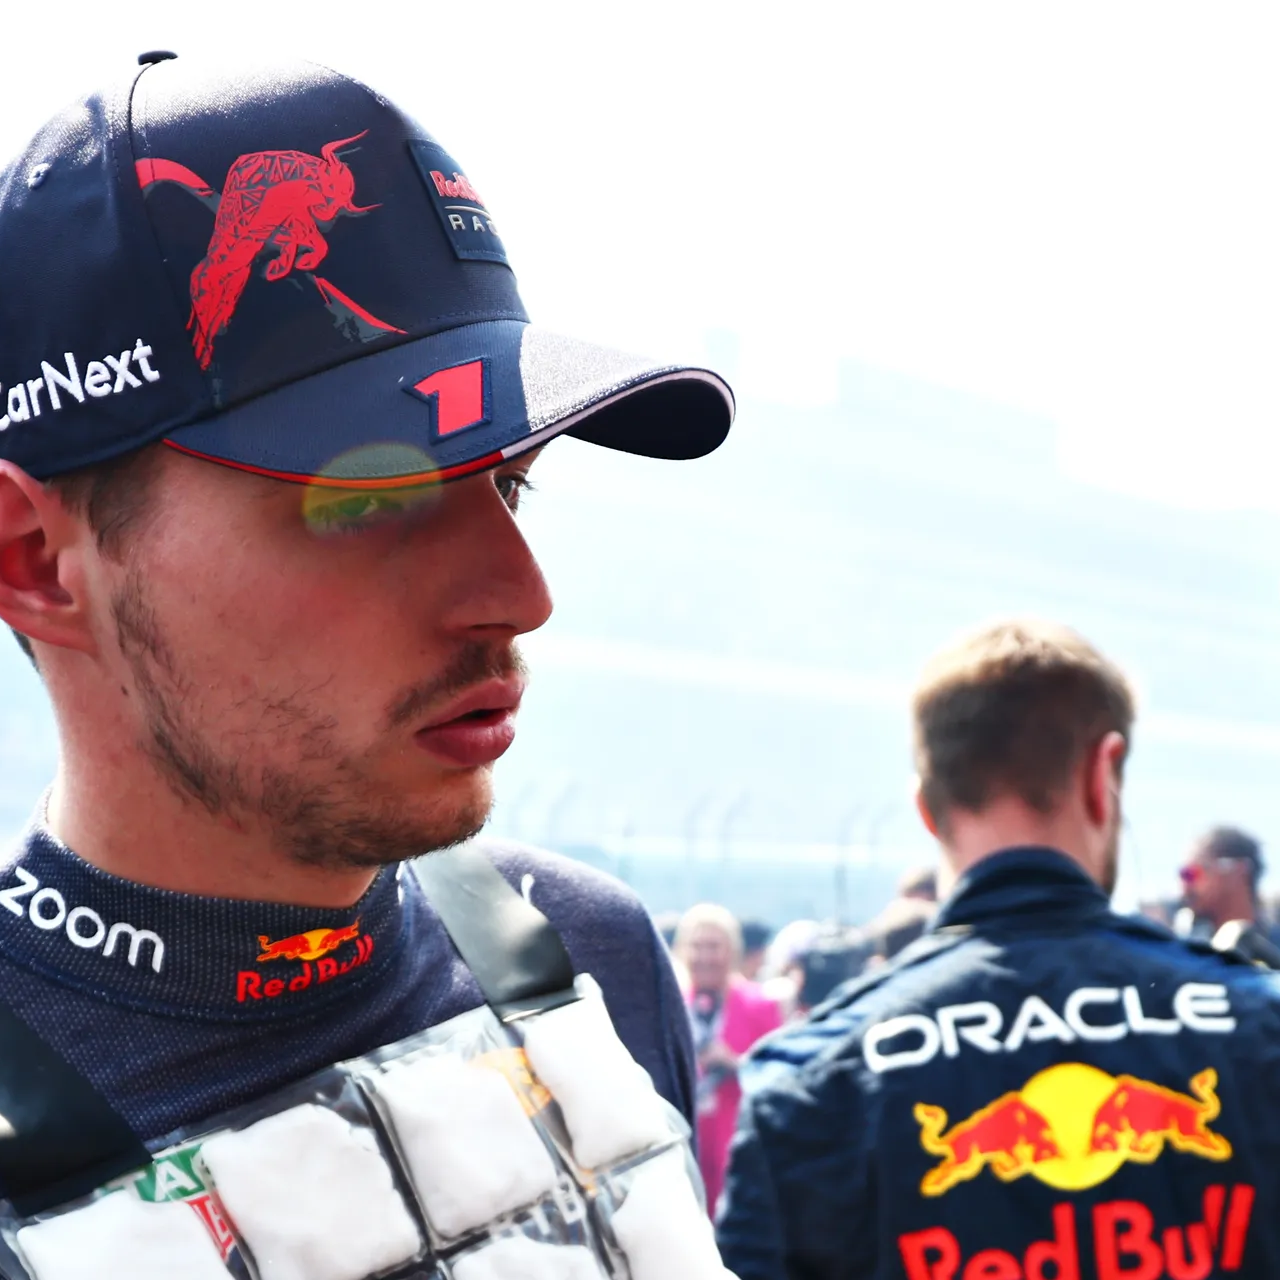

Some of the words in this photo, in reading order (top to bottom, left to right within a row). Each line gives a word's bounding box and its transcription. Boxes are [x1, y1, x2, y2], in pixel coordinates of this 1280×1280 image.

[447, 213, 500, 237] RAC
[413, 359, 485, 436] 1
[236, 964, 313, 1003] Red
[318, 933, 375, 985] Bull
[862, 982, 1237, 1075] ORACLE
